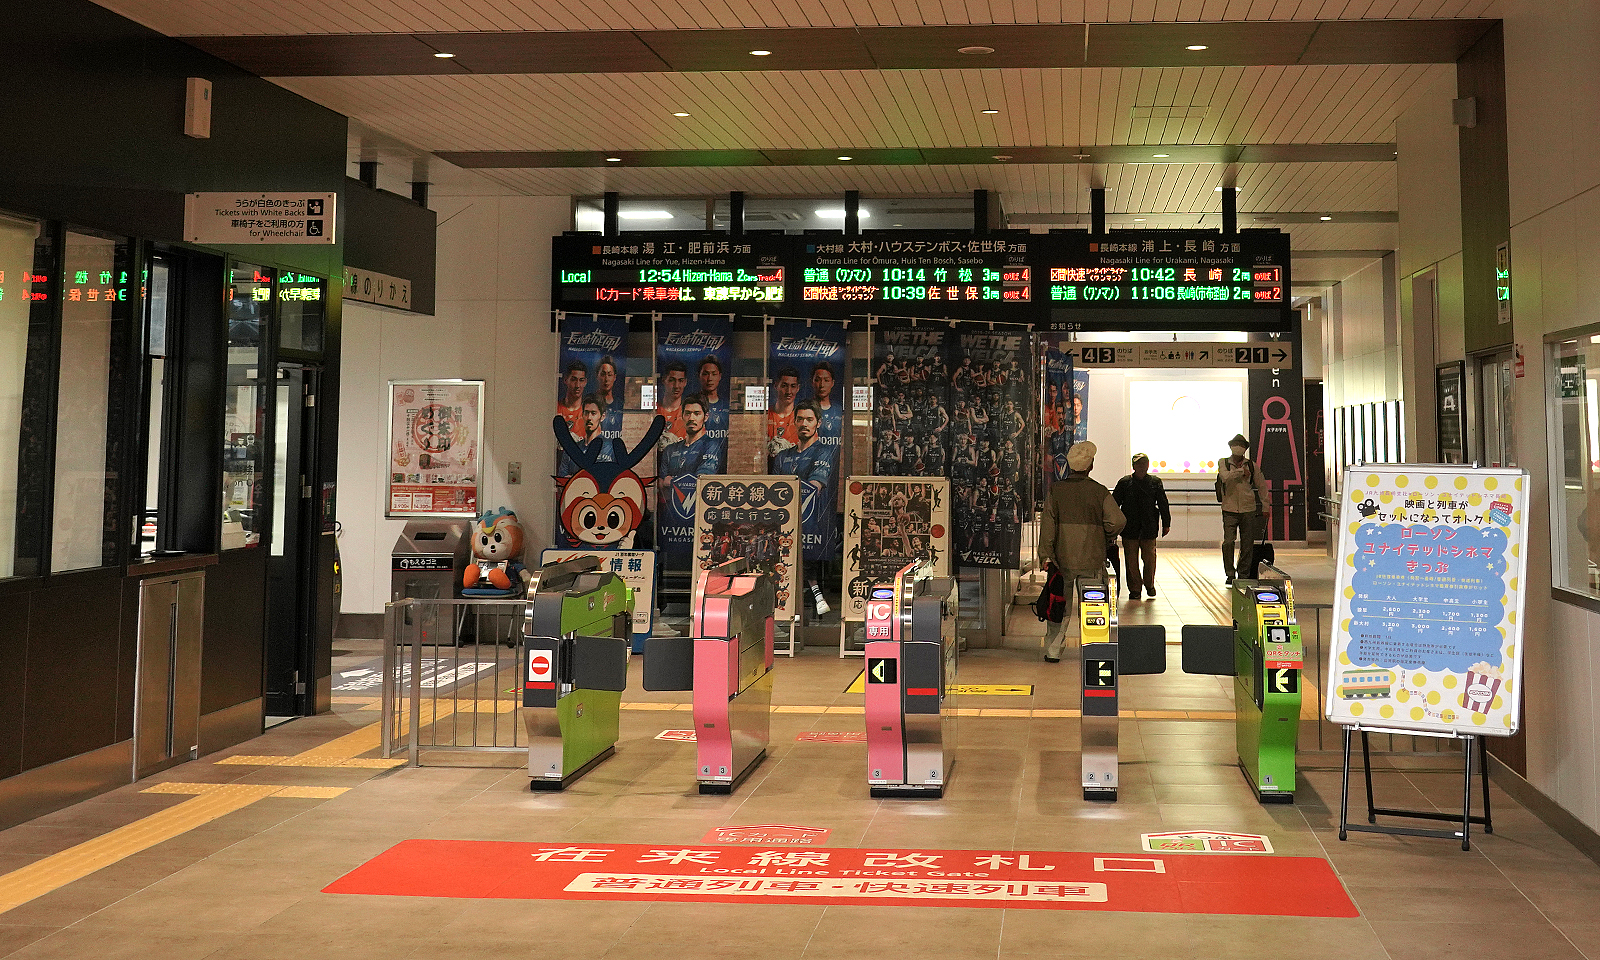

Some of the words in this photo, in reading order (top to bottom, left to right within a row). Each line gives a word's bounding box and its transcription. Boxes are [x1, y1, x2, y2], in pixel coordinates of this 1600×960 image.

[235, 200, 305, 208] うらが白色のきっぷ
[231, 220, 304, 228] 車椅子をご利用の方
[602, 246, 639, 254] 長崎本線
[733, 245, 751, 253] 方面
[816, 245, 844, 253] 大村線
[848, 241, 1006, 253] 大村・ハウステンボス・佐世保
[1008, 244, 1027, 252] 方面
[1100, 244, 1137, 252] 長崎本線
[1142, 240, 1215, 252] 浦上・長崎
[1220, 243, 1241, 252] 方面
[872, 257, 899, 265] Ōmura,
[933, 257, 956, 265] Bosch,
[562, 270, 591, 283] Local
[639, 269, 681, 282] 12:54
[882, 268, 926, 281] 10:14
[934, 268, 972, 282] 竹松
[983, 269, 999, 281] 3両
[1003, 272, 1020, 281] のりば
[1022, 269, 1029, 281] 4
[1050, 268, 1086, 281] 区間快速
[1132, 268, 1175, 281] 10:42
[1183, 268, 1222, 281] 長崎
[1233, 269, 1250, 281] 2両
[1254, 272, 1271, 281] のりば
[1274, 269, 1279, 281] 1
[803, 286, 838, 300] 区間快速
[882, 286, 926, 299] 10:39
[928, 286, 978, 300] 佐世保
[983, 287, 999, 300] 3両
[1003, 291, 1020, 300] のりば
[1022, 287, 1029, 300] 4
[1132, 287, 1175, 300] 11:06
[1233, 287, 1250, 300] 2両
[1254, 291, 1271, 300] のりば
[1273, 287, 1281, 300] 2
[706, 485, 789, 501] 新幹線で
[1405, 500, 1468, 510] 映画と列車が
[707, 511, 785, 520] 応援に行こう
[1401, 528, 1457, 540] ローソン
[1363, 542, 1494, 559] ユナイテッドシネマ
[610, 558, 642, 572] 情報
[1406, 560, 1448, 573] きっぷ
[853, 600, 862, 609] 応
[868, 604, 890, 620] IC
[869, 626, 889, 636] 専用
[530, 847, 1166, 873] 在来線改札口
[590, 877, 1090, 897] 普通列車・快速列車
